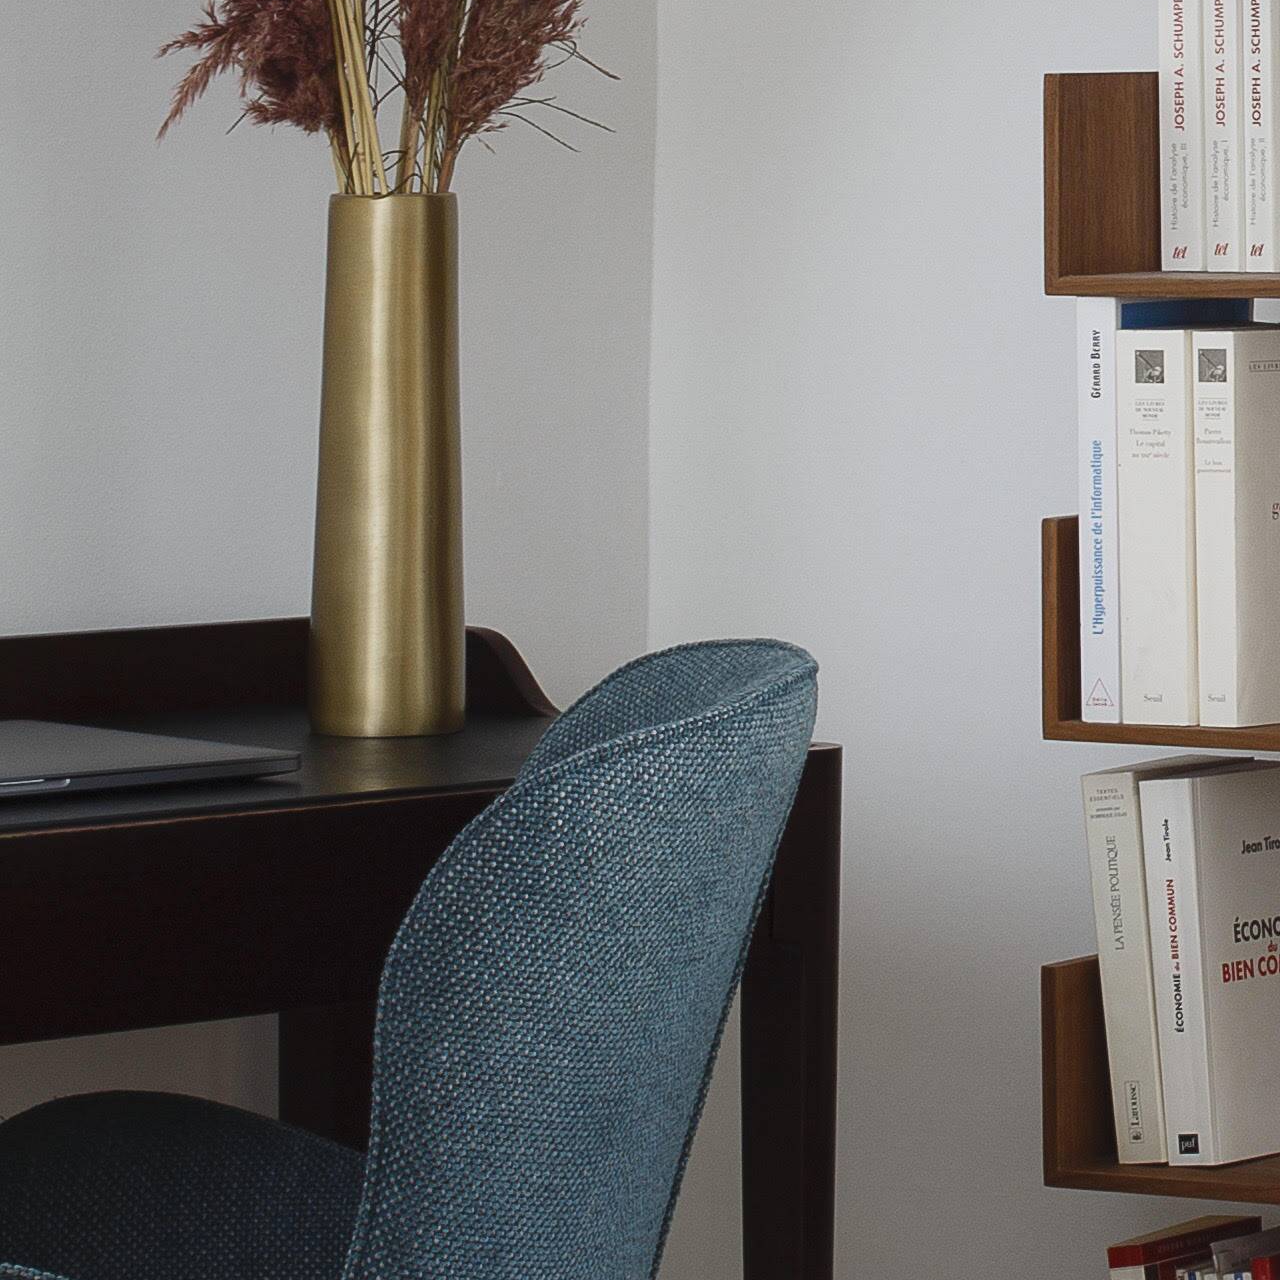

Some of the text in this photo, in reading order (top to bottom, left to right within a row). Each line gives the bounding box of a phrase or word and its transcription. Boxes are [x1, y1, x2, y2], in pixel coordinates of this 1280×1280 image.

[1174, 64, 1184, 77] A.
[1215, 59, 1225, 73] A.
[1251, 59, 1261, 73] A.
[1174, 80, 1185, 131] JOSEPH
[1215, 77, 1226, 127] JOSEPH
[1252, 77, 1262, 127] JOSEPH
[1241, 840, 1263, 855] Jean
[1222, 962, 1255, 983] BIEN
